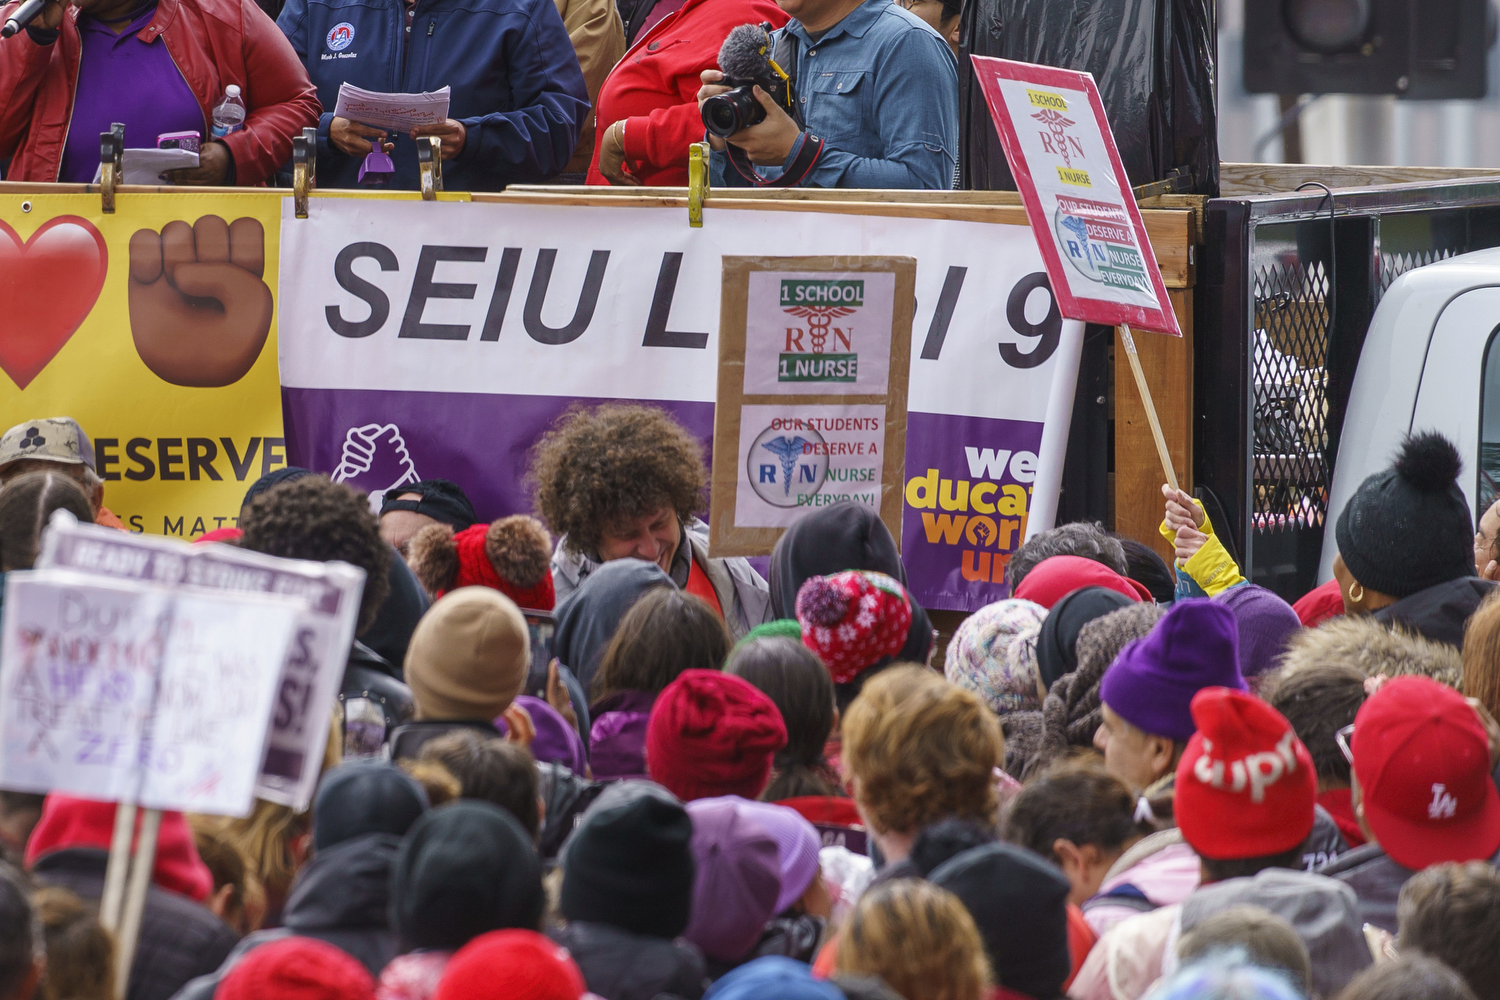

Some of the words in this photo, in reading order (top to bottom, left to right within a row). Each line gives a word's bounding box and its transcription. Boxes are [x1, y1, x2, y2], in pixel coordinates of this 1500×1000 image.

[1028, 92, 1035, 103] 1
[1035, 94, 1068, 110] SCHOOL
[1058, 169, 1063, 181] 1
[1064, 171, 1091, 185] NURSE
[1058, 199, 1078, 213] OUR
[1078, 202, 1127, 222] STUDENTS
[1086, 224, 1126, 242] DESERVE
[1109, 251, 1142, 267] NURSE
[781, 286, 789, 301] 1
[797, 285, 864, 302] SCHOOL
[323, 240, 612, 345] SEIU
[997, 271, 1063, 369] 9
[779, 360, 789, 377] 1
[796, 360, 857, 377] NURSE
[771, 417, 802, 431] OUR
[807, 417, 879, 431] STUDENTS
[802, 442, 864, 456] DESERVE
[868, 442, 878, 456] A
[965, 446, 1039, 483] we
[826, 467, 876, 482] NURSE
[904, 468, 1034, 516] duca
[921, 512, 1028, 549] wor
